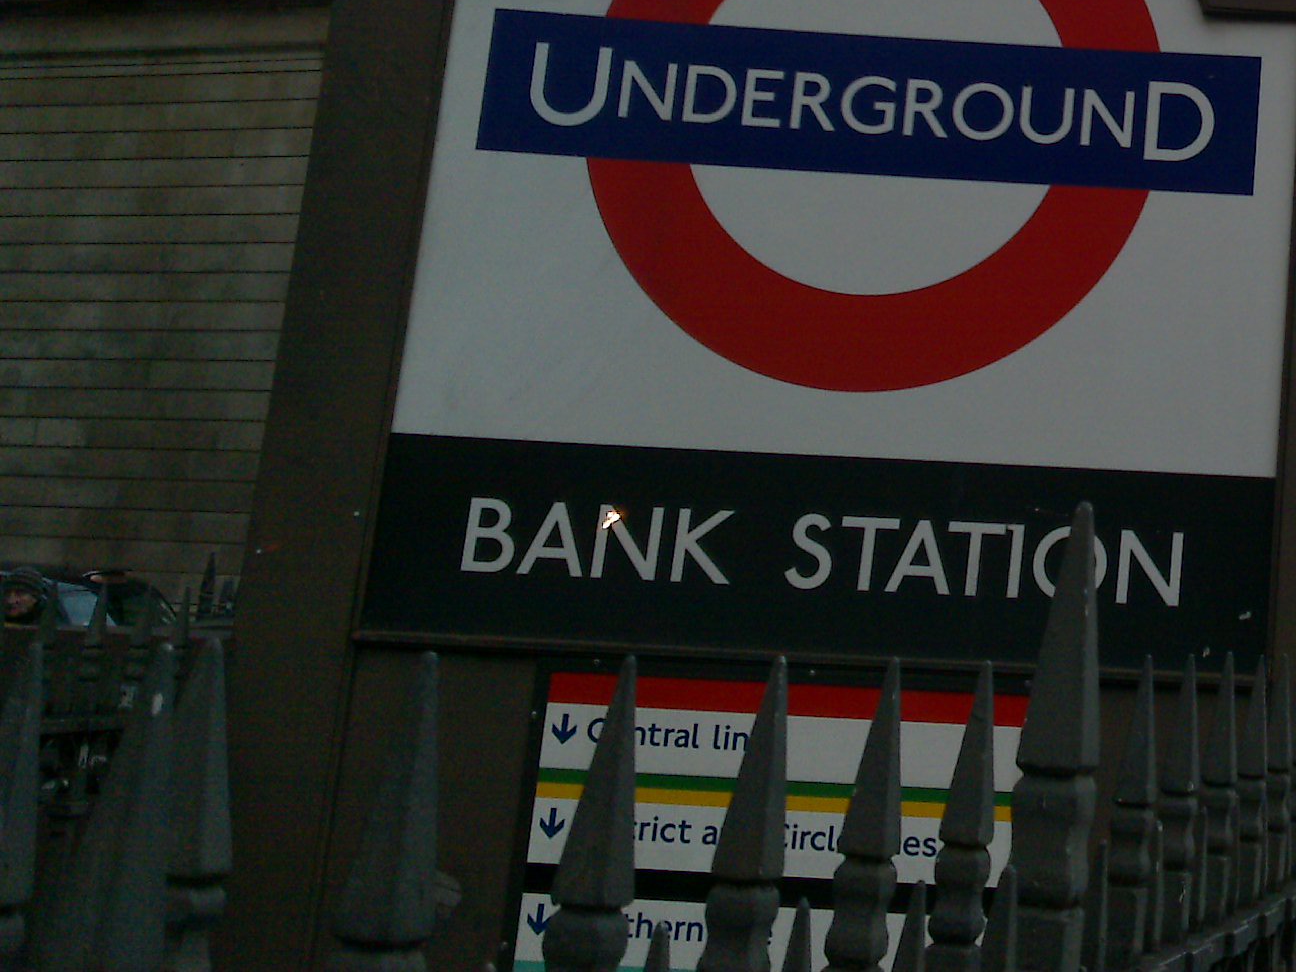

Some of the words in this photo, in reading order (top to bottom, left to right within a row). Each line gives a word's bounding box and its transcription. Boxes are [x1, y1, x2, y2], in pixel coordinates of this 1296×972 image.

[529, 41, 1215, 162] UNDERGROUND
[460, 497, 735, 585] BANK
[784, 513, 1184, 607] STATION
[587, 718, 698, 749] Cntral
[712, 724, 749, 751] lin
[784, 823, 835, 852] ircl
